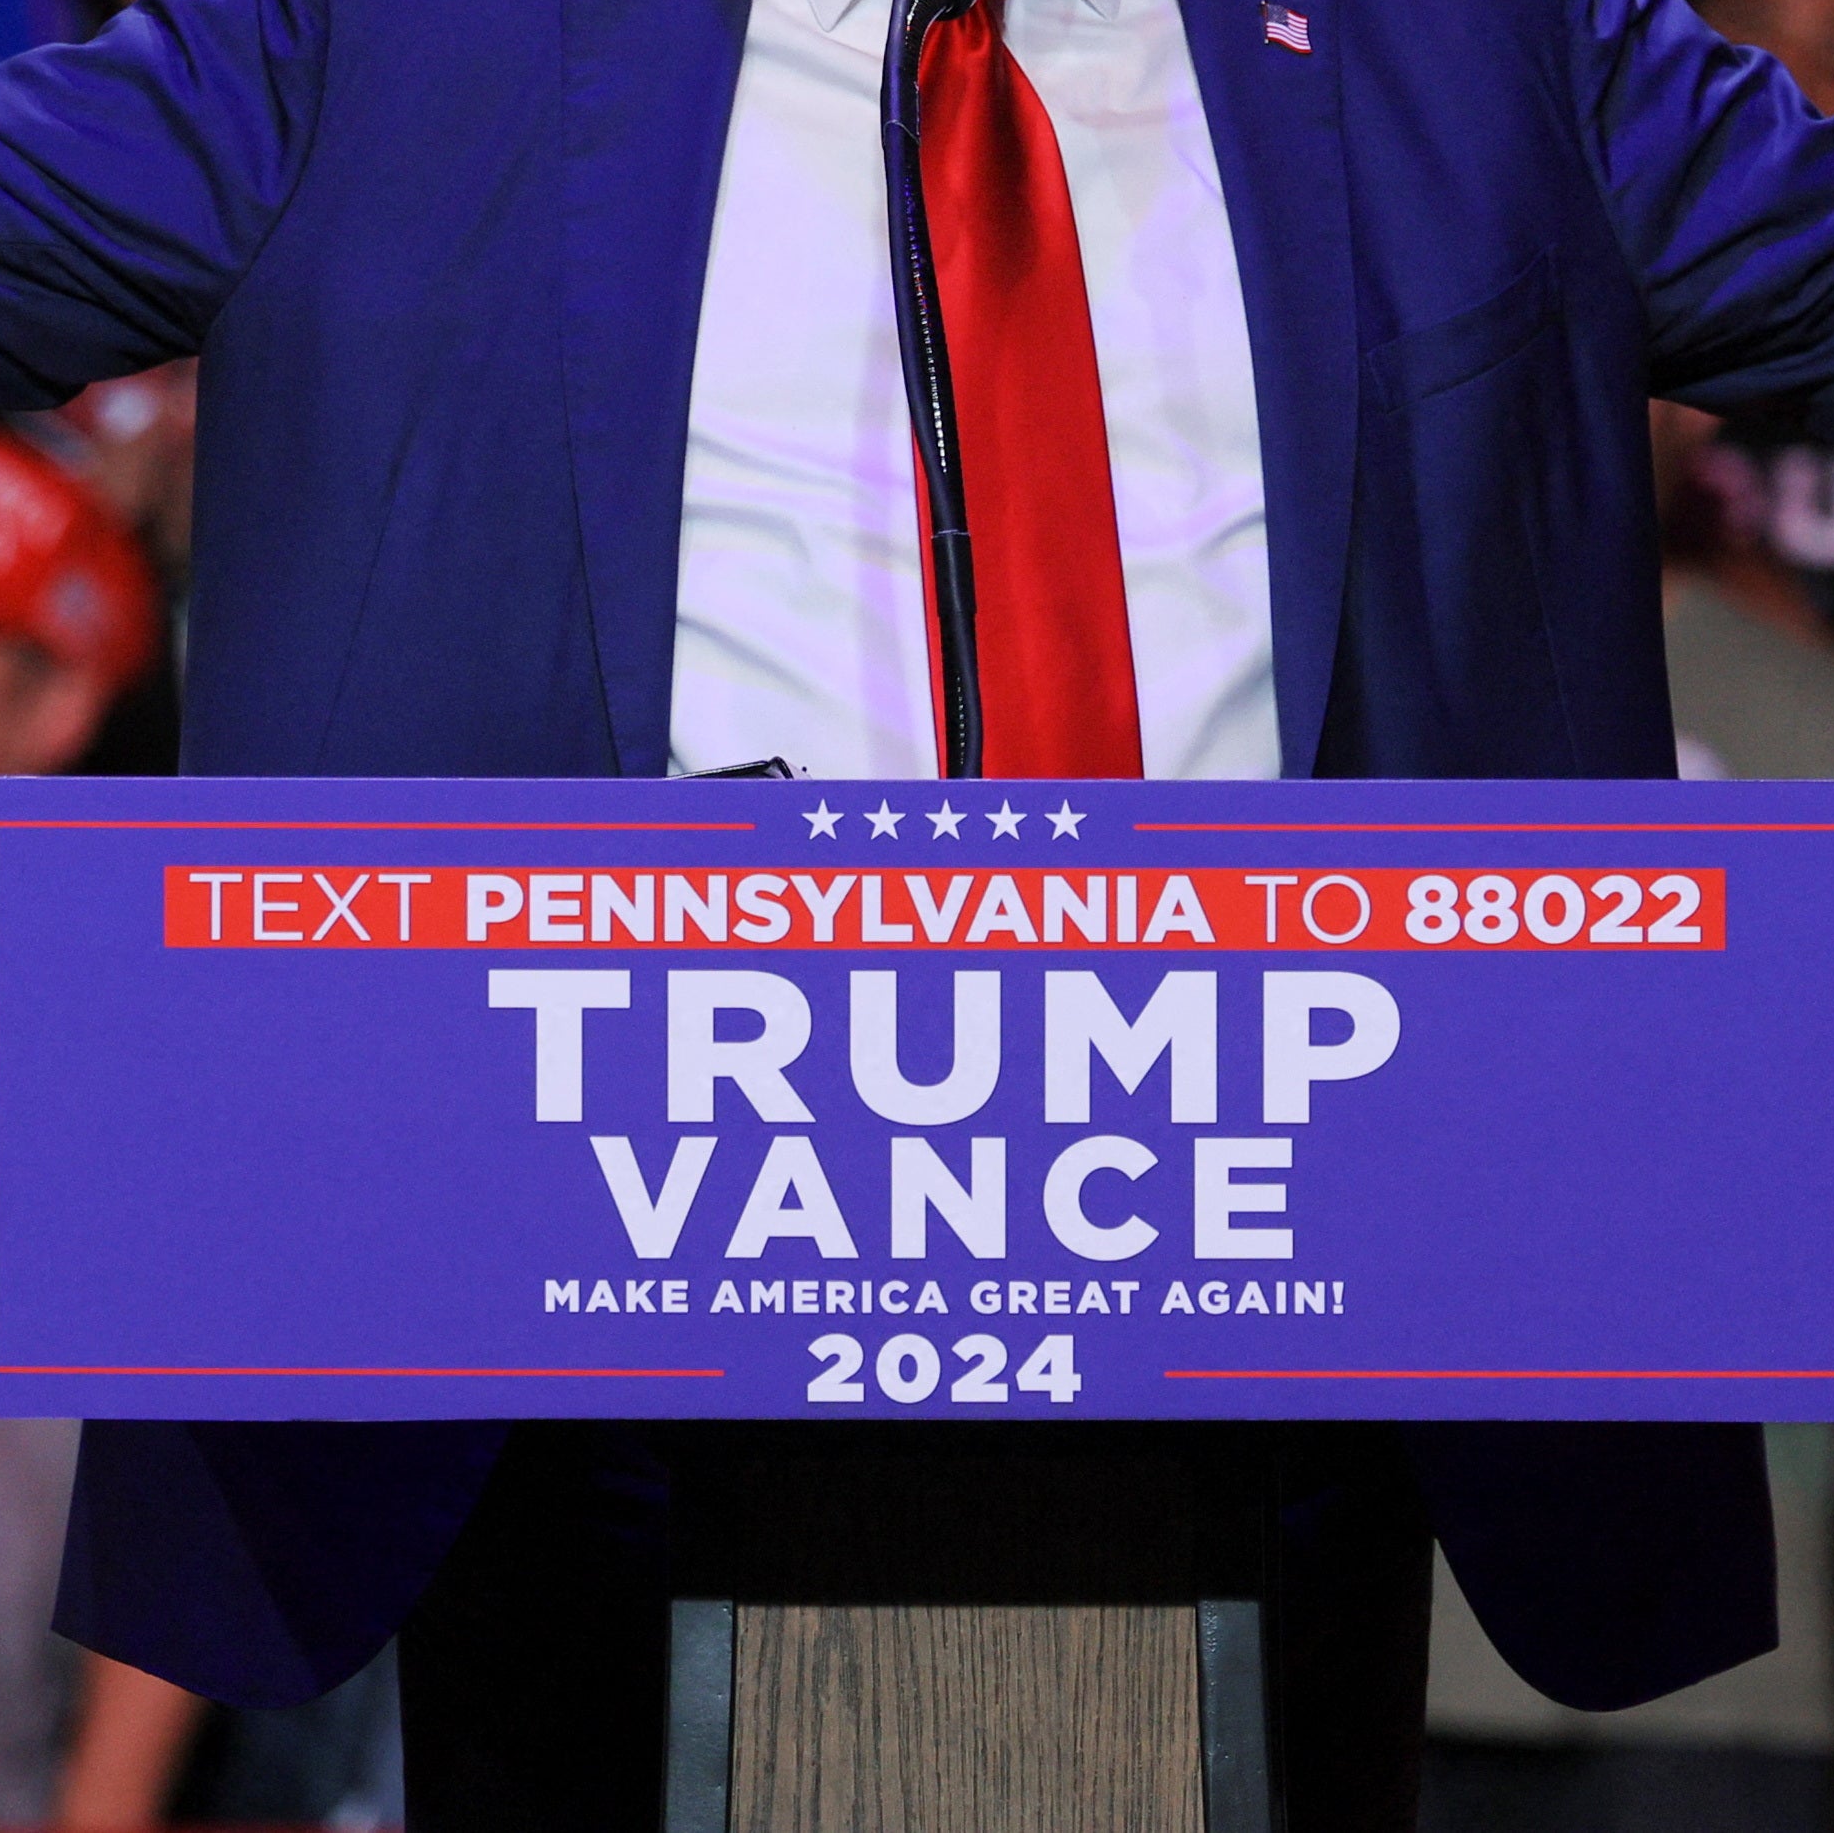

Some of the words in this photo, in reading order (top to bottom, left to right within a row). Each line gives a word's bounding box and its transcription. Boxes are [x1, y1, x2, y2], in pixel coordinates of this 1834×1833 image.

[189, 873, 432, 941] TEXT
[466, 873, 1216, 943] PENNSYLVANIA
[1244, 874, 1371, 944] TO
[1405, 874, 1701, 944] 88022
[488, 969, 1401, 1126] TRUMP
[589, 1135, 1294, 1261] VANCE
[545, 1279, 689, 1313] MAKE
[710, 1280, 949, 1314] AMERICA
[970, 1280, 1140, 1314] GREAT
[1160, 1281, 1345, 1315] AGAIN!
[807, 1333, 1082, 1404] 2024
